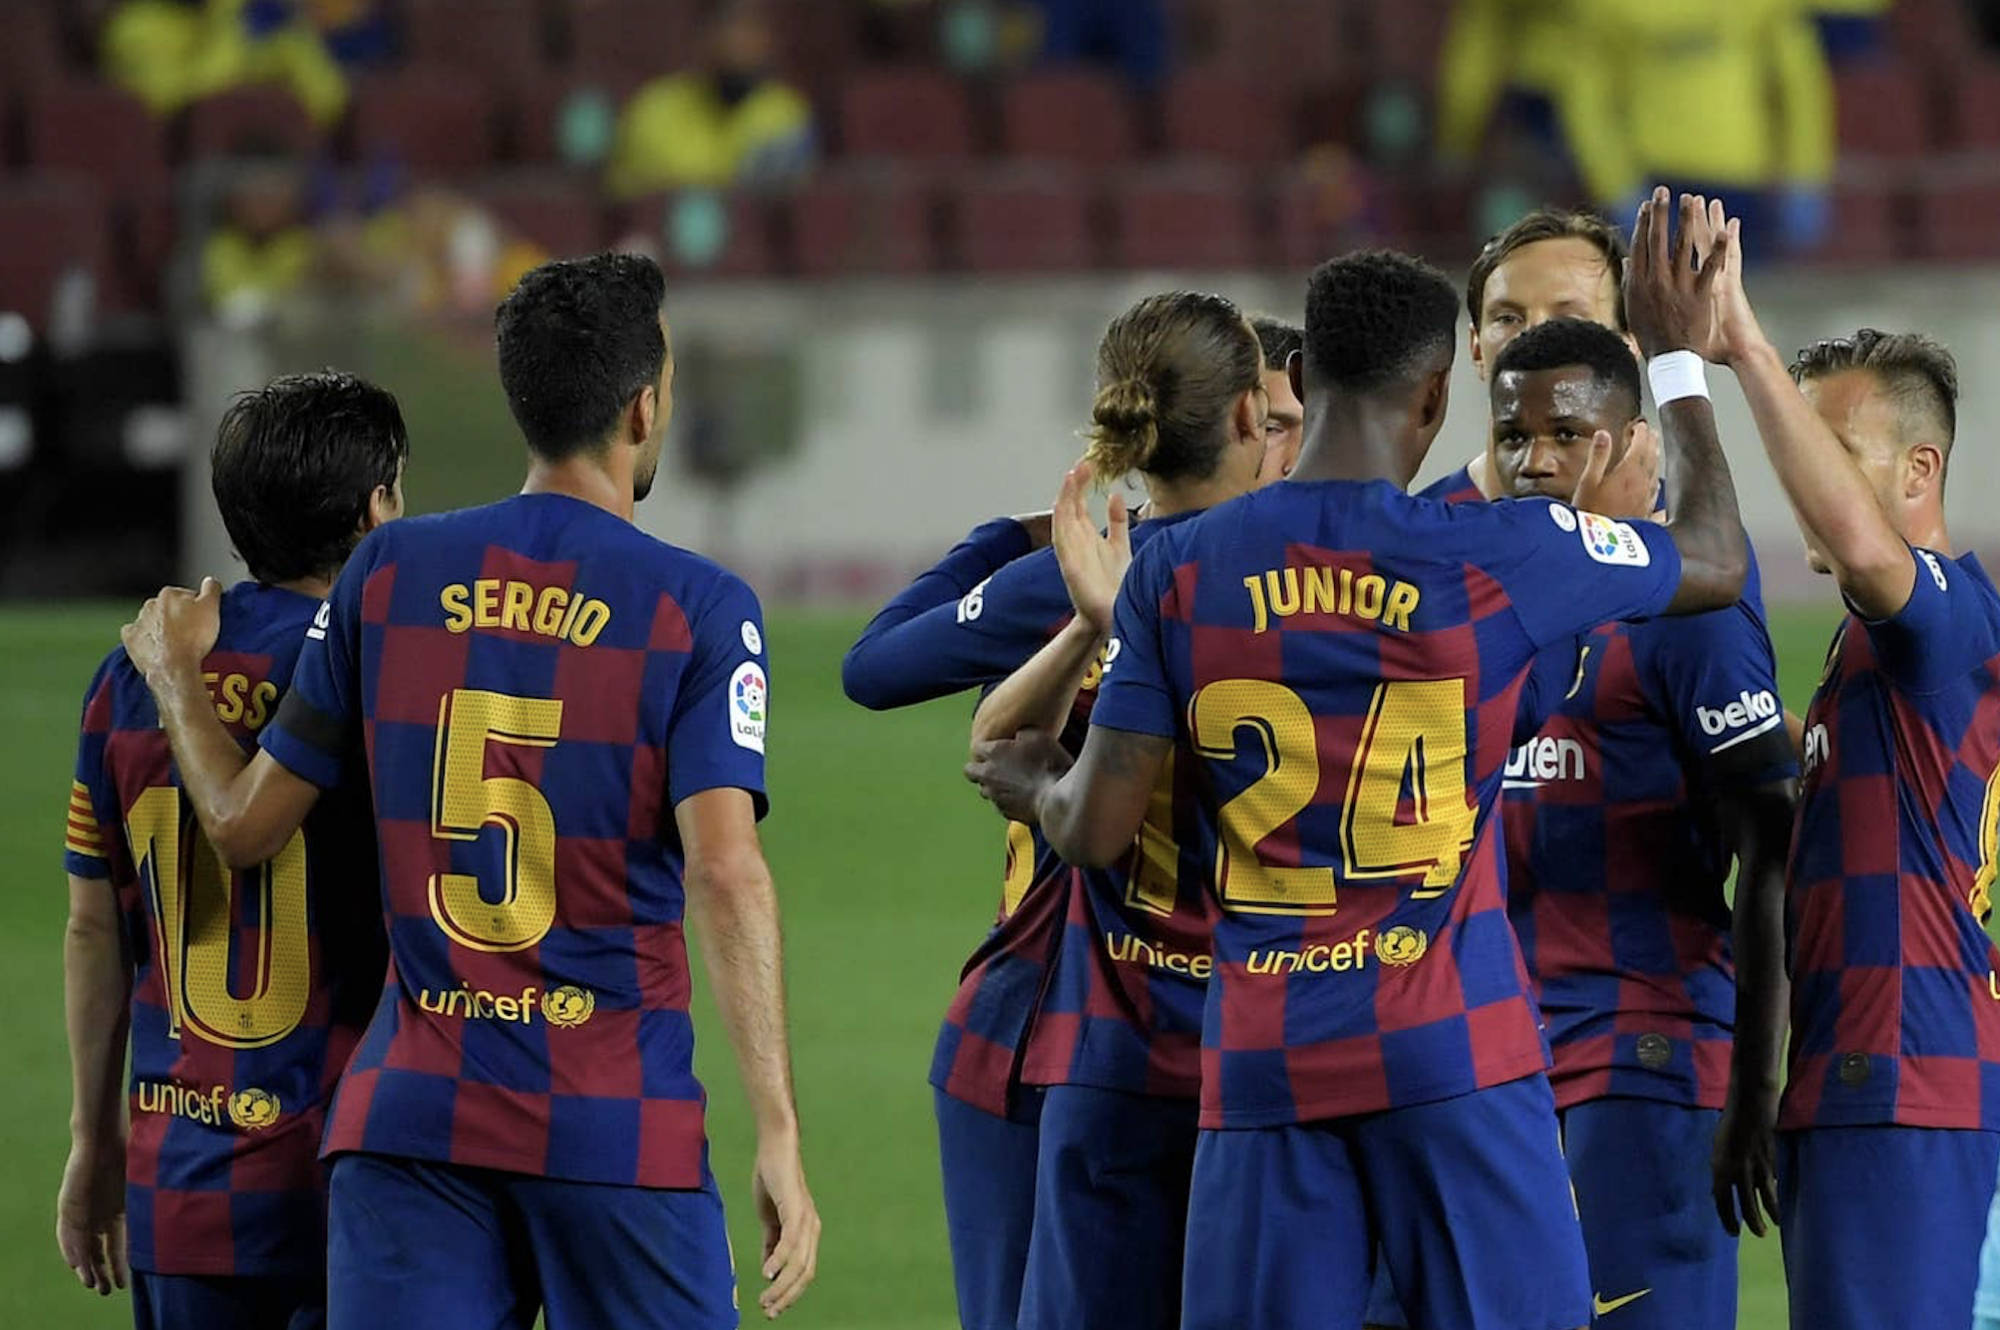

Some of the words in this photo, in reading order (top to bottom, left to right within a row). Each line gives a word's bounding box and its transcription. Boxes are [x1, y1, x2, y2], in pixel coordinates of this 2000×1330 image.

[440, 579, 610, 647] SERGIO
[1243, 566, 1420, 635] JUNIOR
[1696, 689, 1777, 736] beko
[428, 688, 563, 952] 5
[1187, 678, 1479, 917] 24
[127, 786, 310, 1048] 10
[1246, 929, 1370, 976] unicef
[419, 981, 537, 1025] unicef
[138, 1079, 225, 1127] unicef
